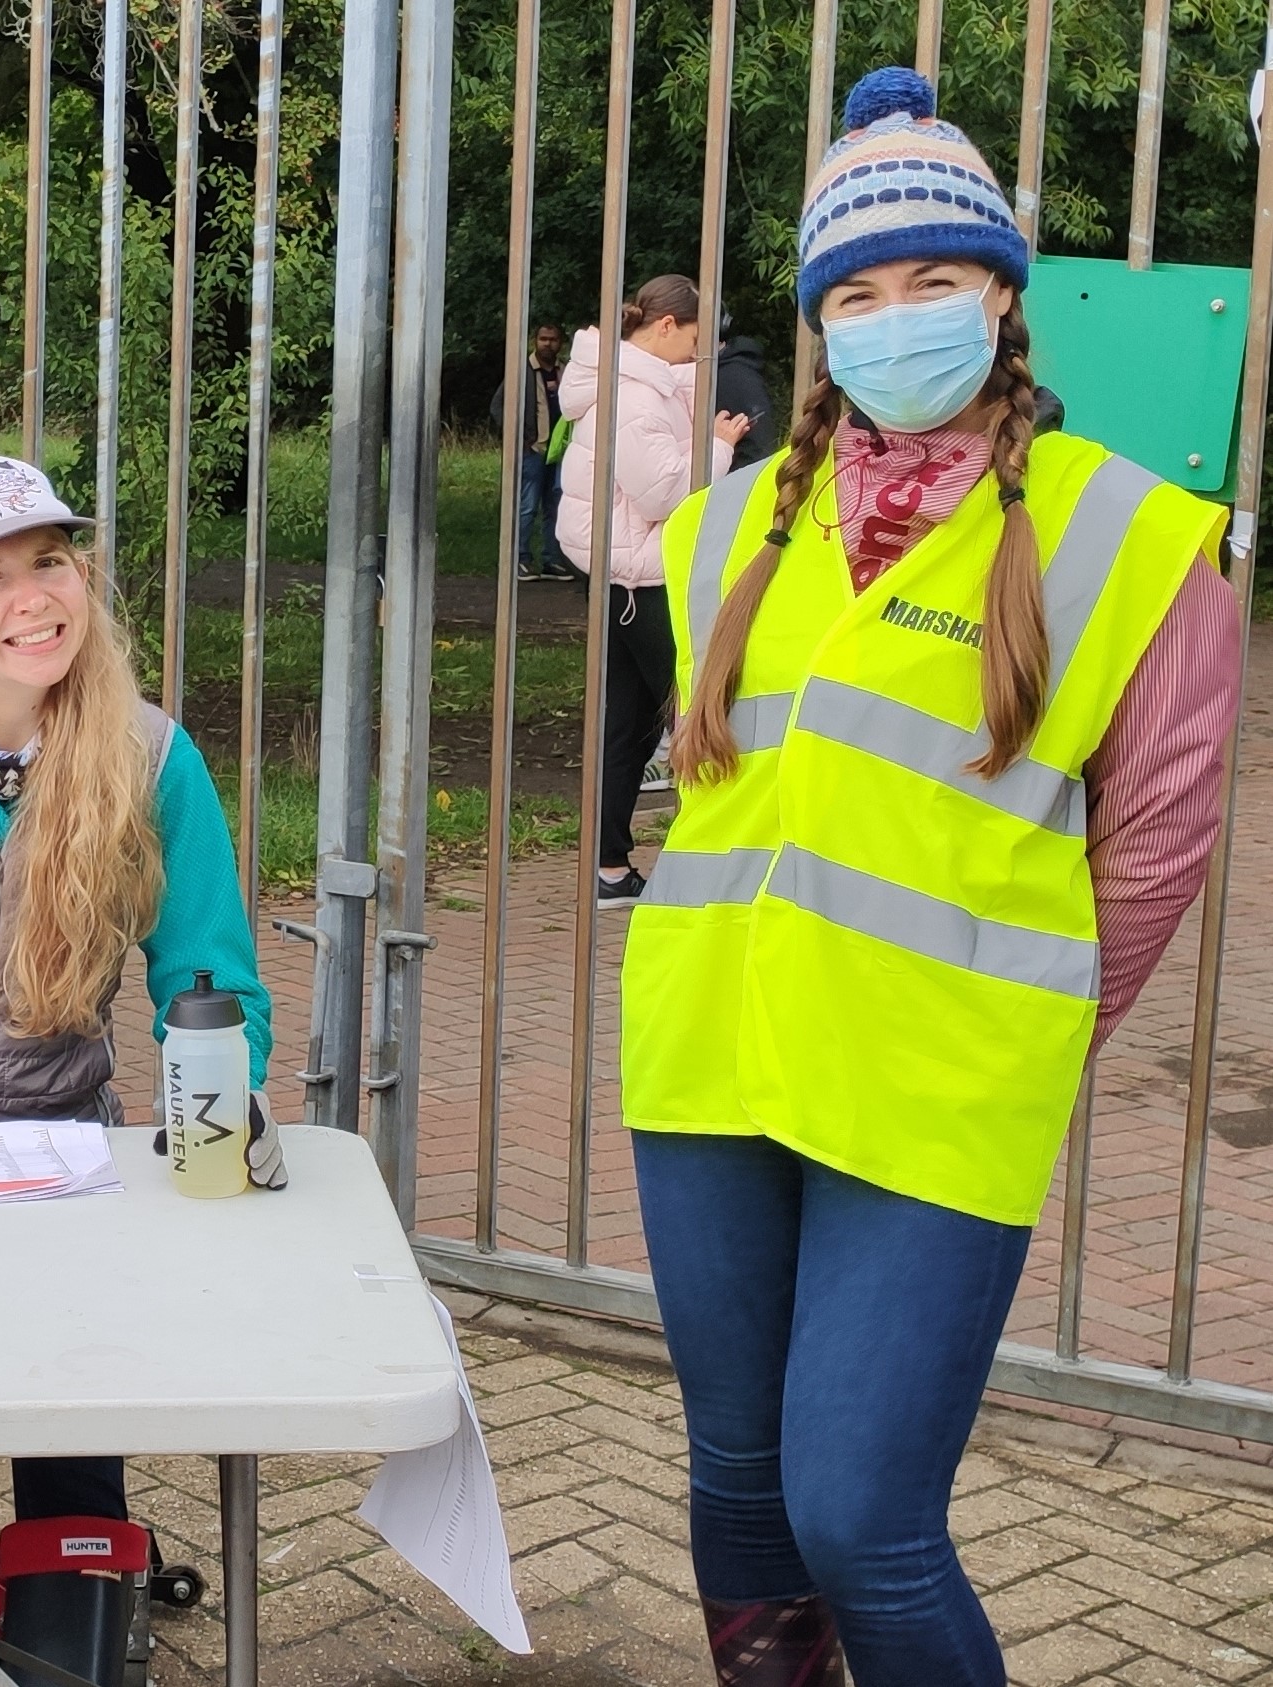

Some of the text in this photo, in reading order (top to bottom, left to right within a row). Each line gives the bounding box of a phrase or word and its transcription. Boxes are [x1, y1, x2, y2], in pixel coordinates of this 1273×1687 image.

[880, 596, 985, 652] MARSHA
[168, 1061, 187, 1173] MAURTEN
[66, 1542, 109, 1551] HUNTER
